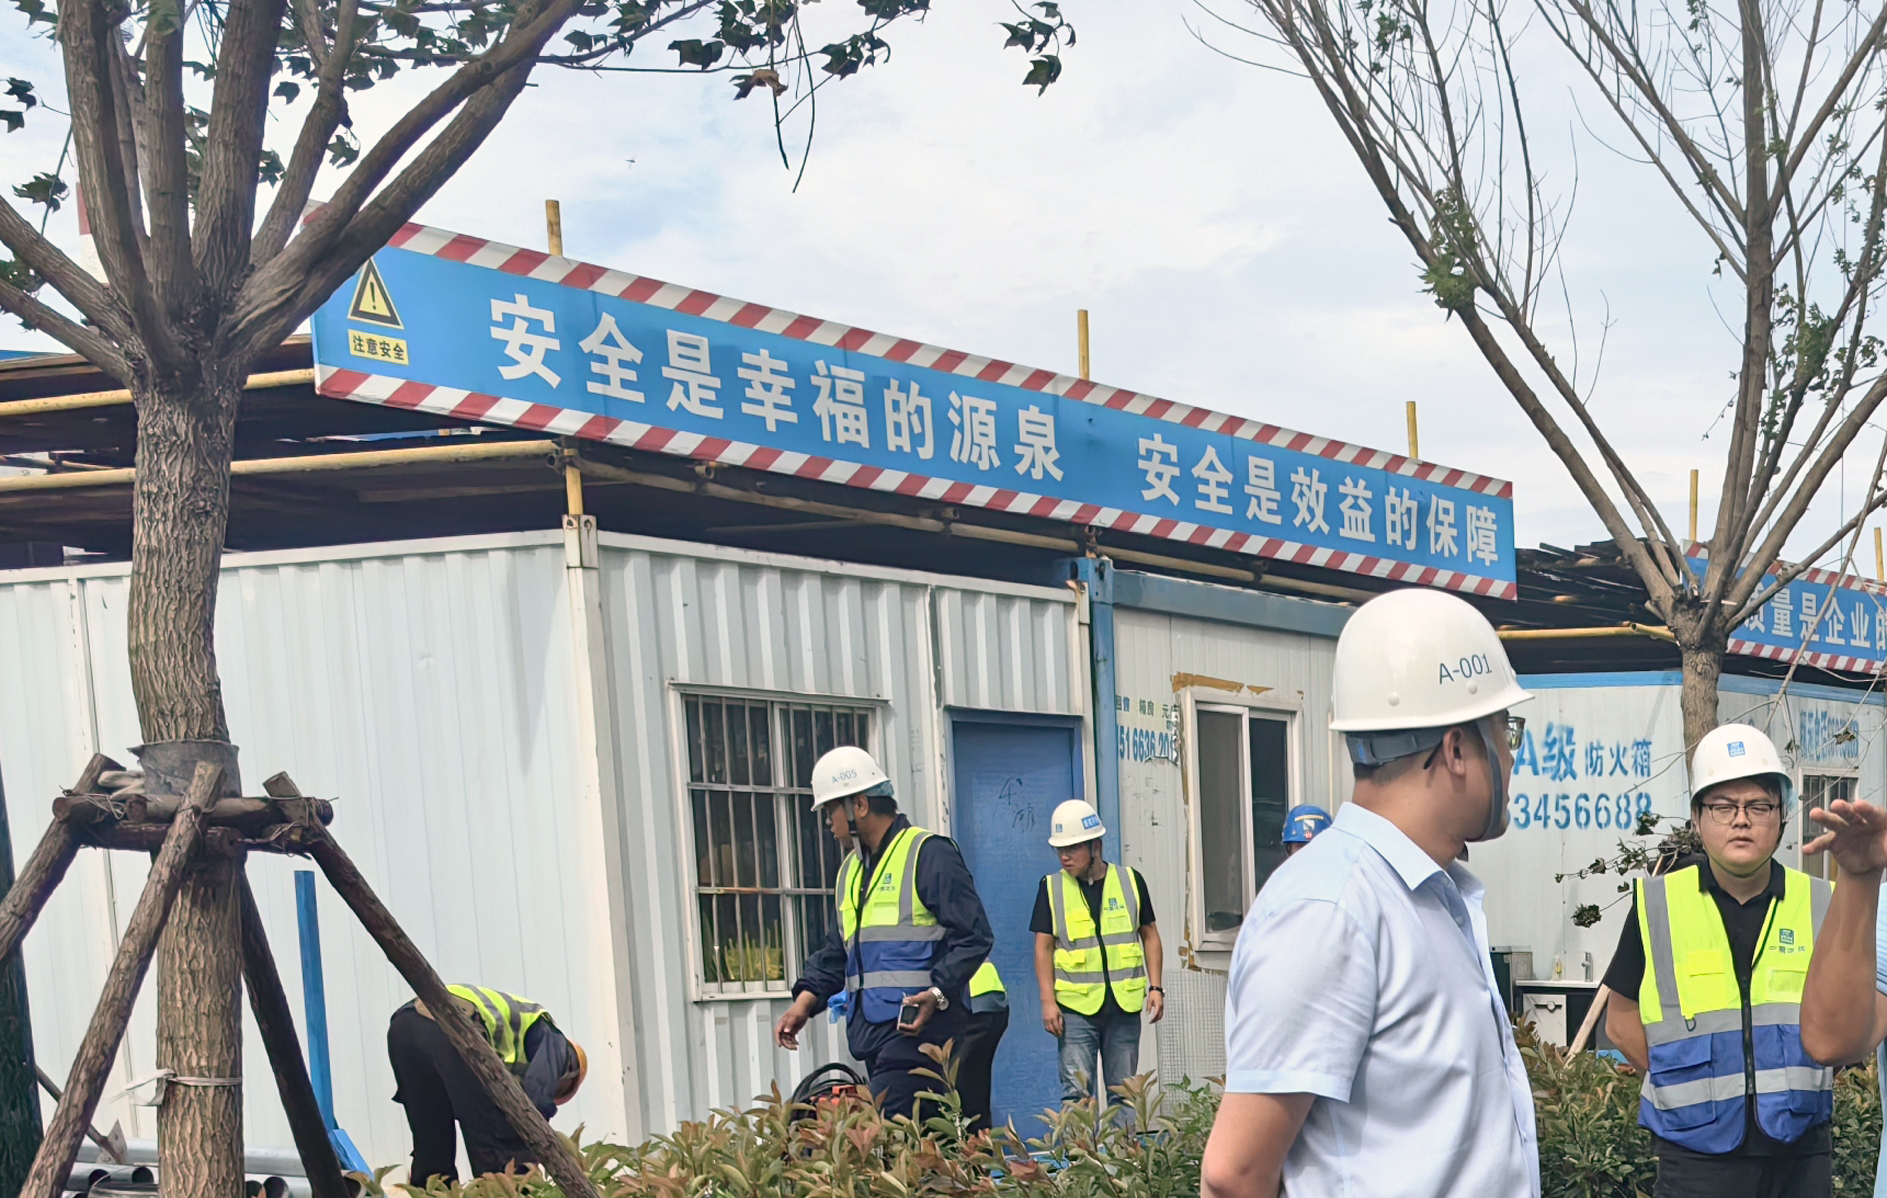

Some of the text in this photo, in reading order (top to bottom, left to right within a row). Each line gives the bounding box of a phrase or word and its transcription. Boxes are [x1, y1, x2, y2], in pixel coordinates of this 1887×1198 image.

[353, 335, 404, 360] 注意安全
[488, 293, 1500, 568] 安全是幸福的源泉 安全是效益的保障
[1439, 653, 1492, 685] A-001
[1513, 721, 1652, 782] A级 防火箱
[1507, 791, 1652, 830] 3456688
